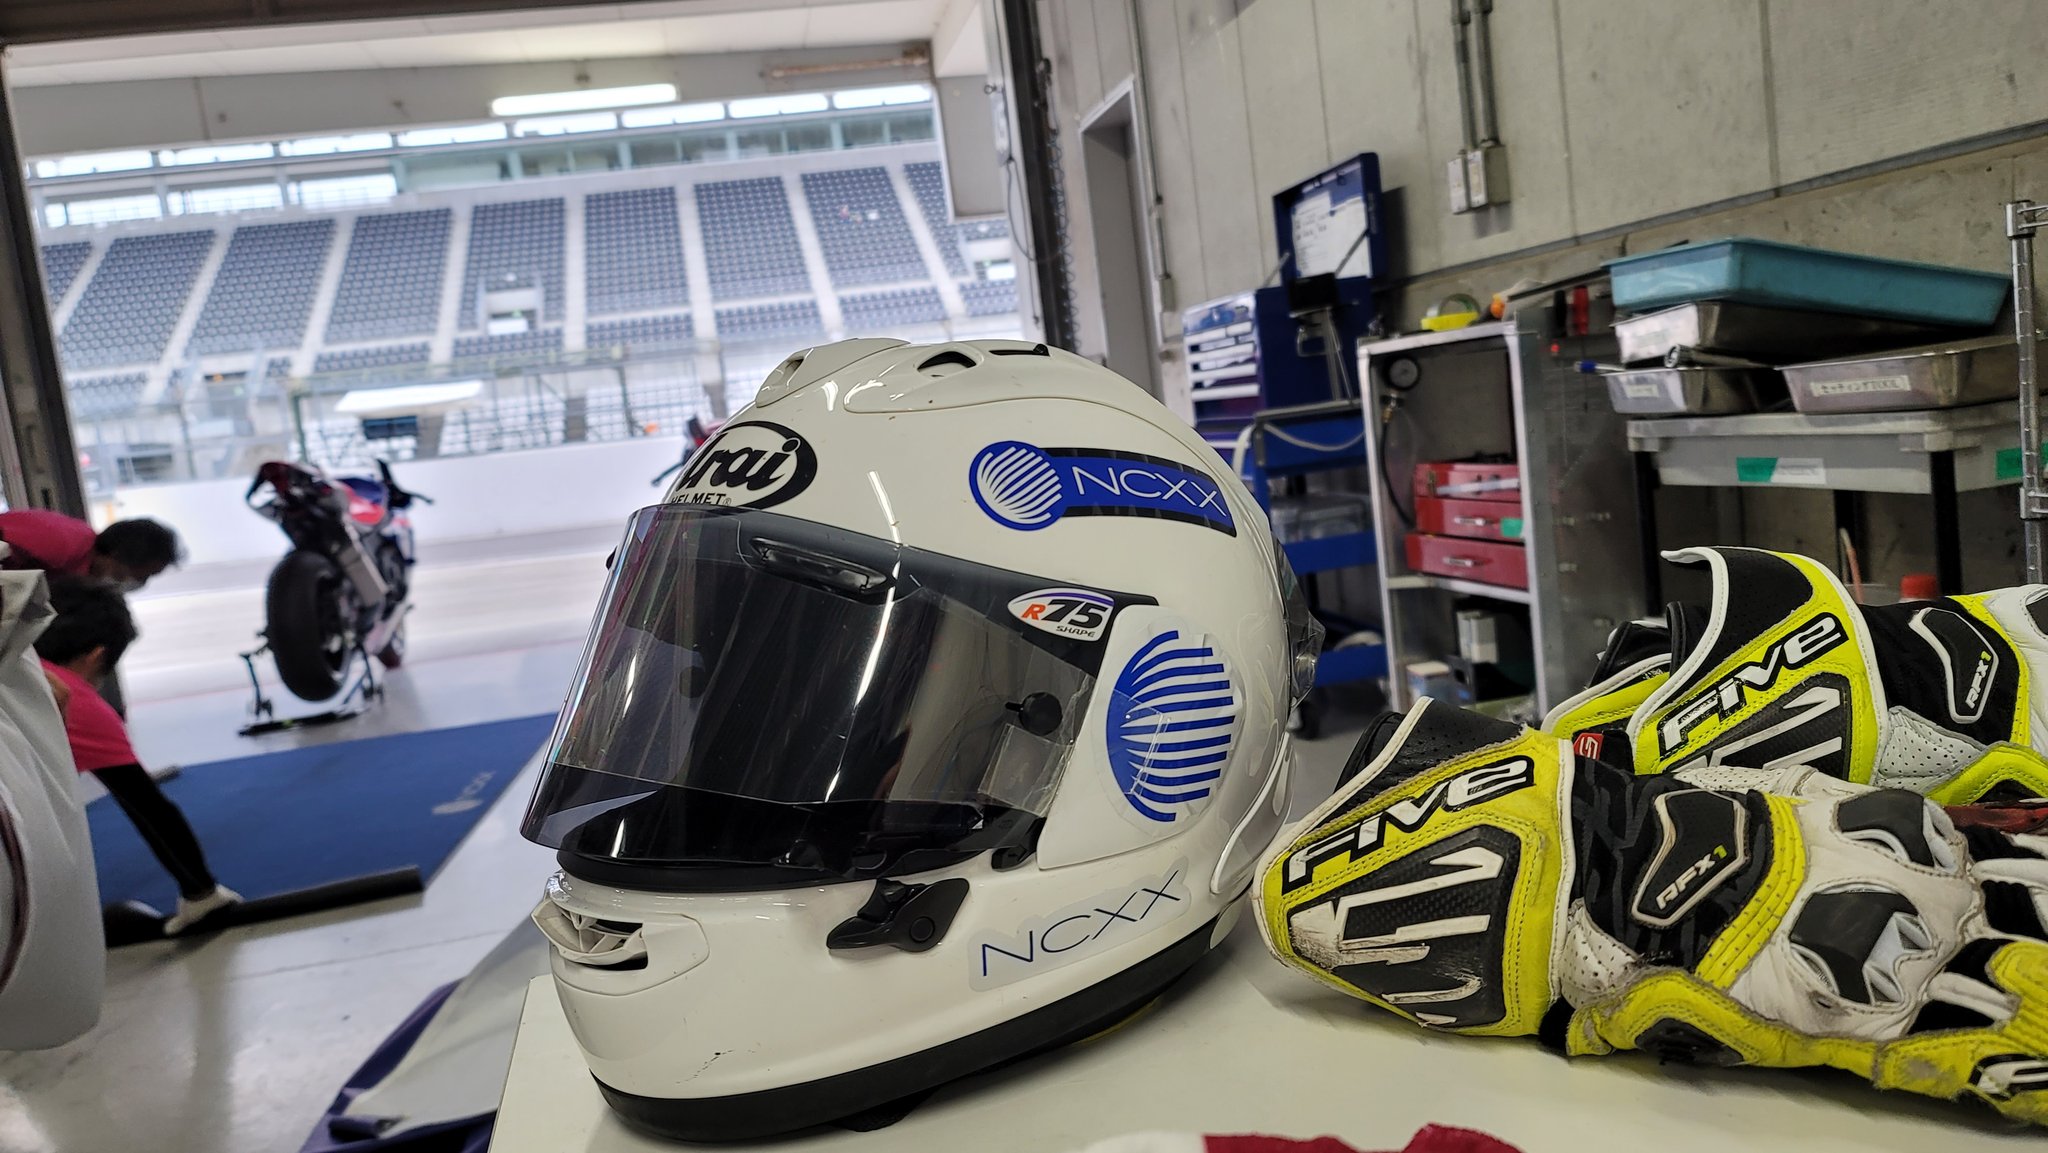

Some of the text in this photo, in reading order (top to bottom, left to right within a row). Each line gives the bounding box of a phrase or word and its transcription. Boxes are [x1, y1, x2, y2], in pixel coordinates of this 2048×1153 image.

[1072, 465, 1227, 517] NCXX
[1021, 598, 1109, 629] R75
[1056, 625, 1096, 638] SHAPE
[982, 869, 1181, 977] NCXX
